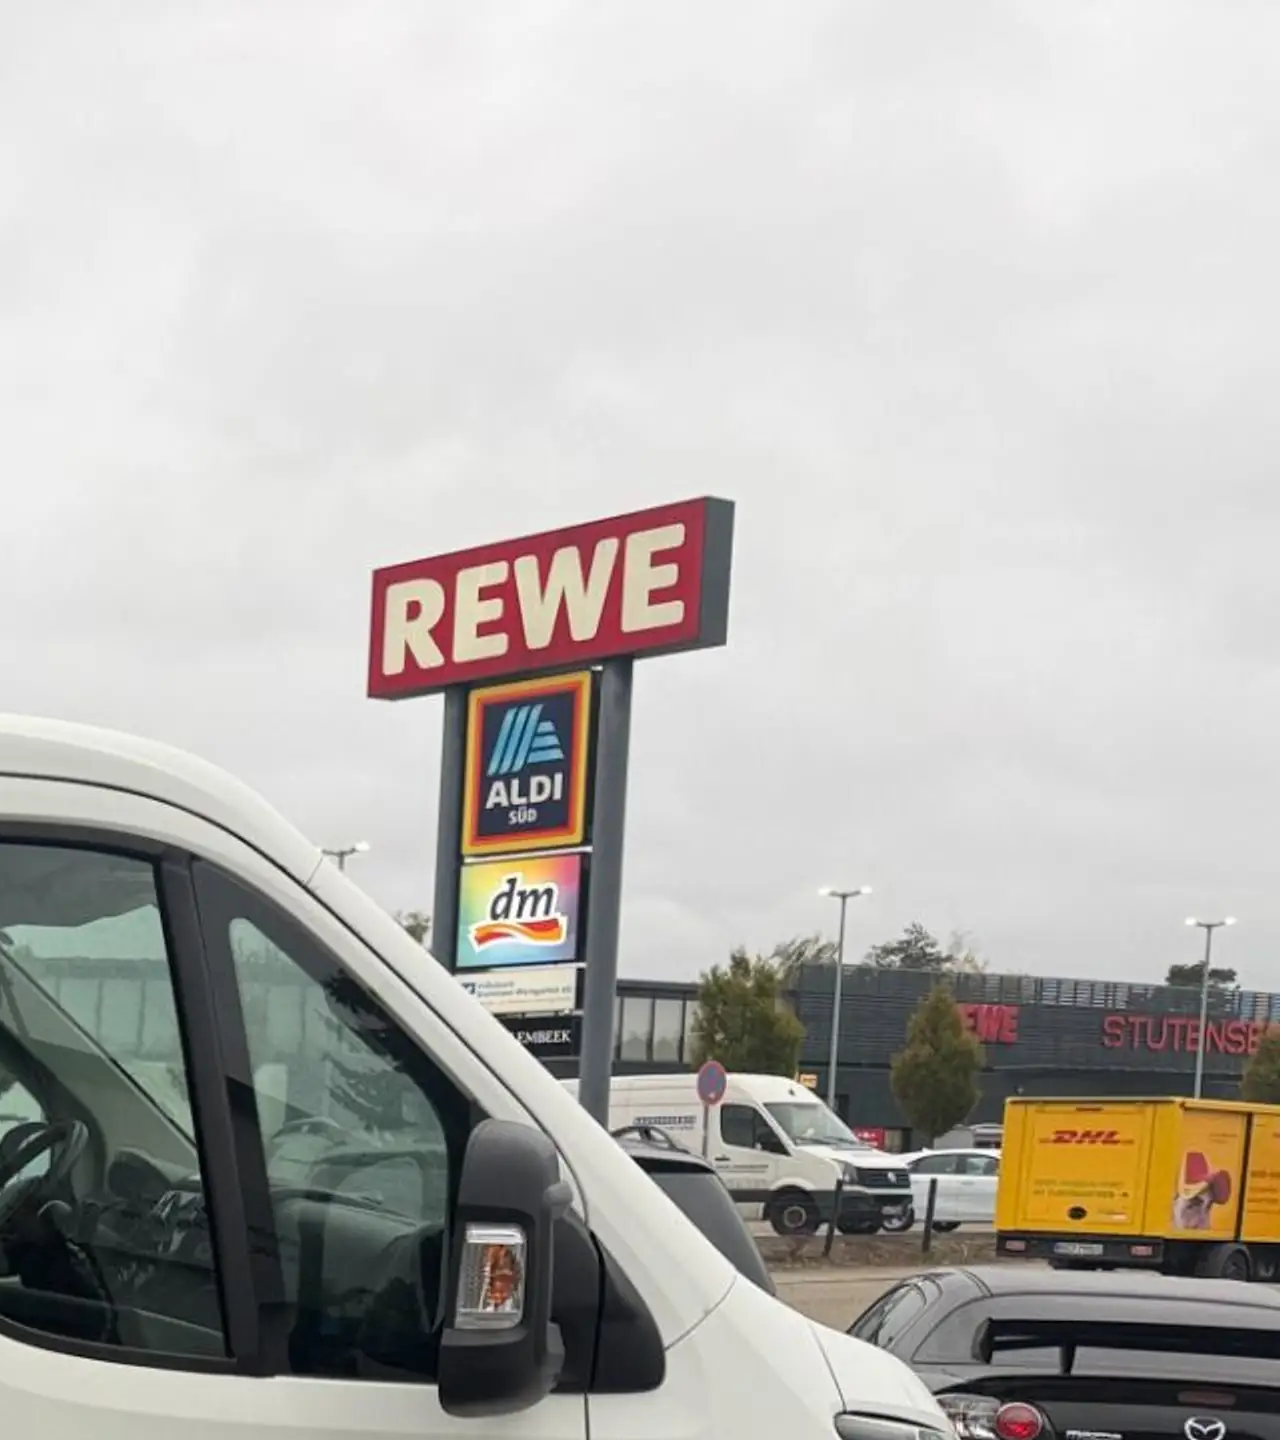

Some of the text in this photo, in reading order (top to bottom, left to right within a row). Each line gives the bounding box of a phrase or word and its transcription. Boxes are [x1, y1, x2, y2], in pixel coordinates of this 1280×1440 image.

[381, 522, 687, 677] REWE
[484, 771, 565, 810] ALDI
[508, 805, 538, 825] SÜD
[489, 877, 555, 922] dm
[513, 1028, 572, 1044] EMBEEK
[957, 1003, 1019, 1043] EWE
[1101, 1014, 1280, 1057] STUTENSE
[1051, 1129, 1122, 1145] DHL
